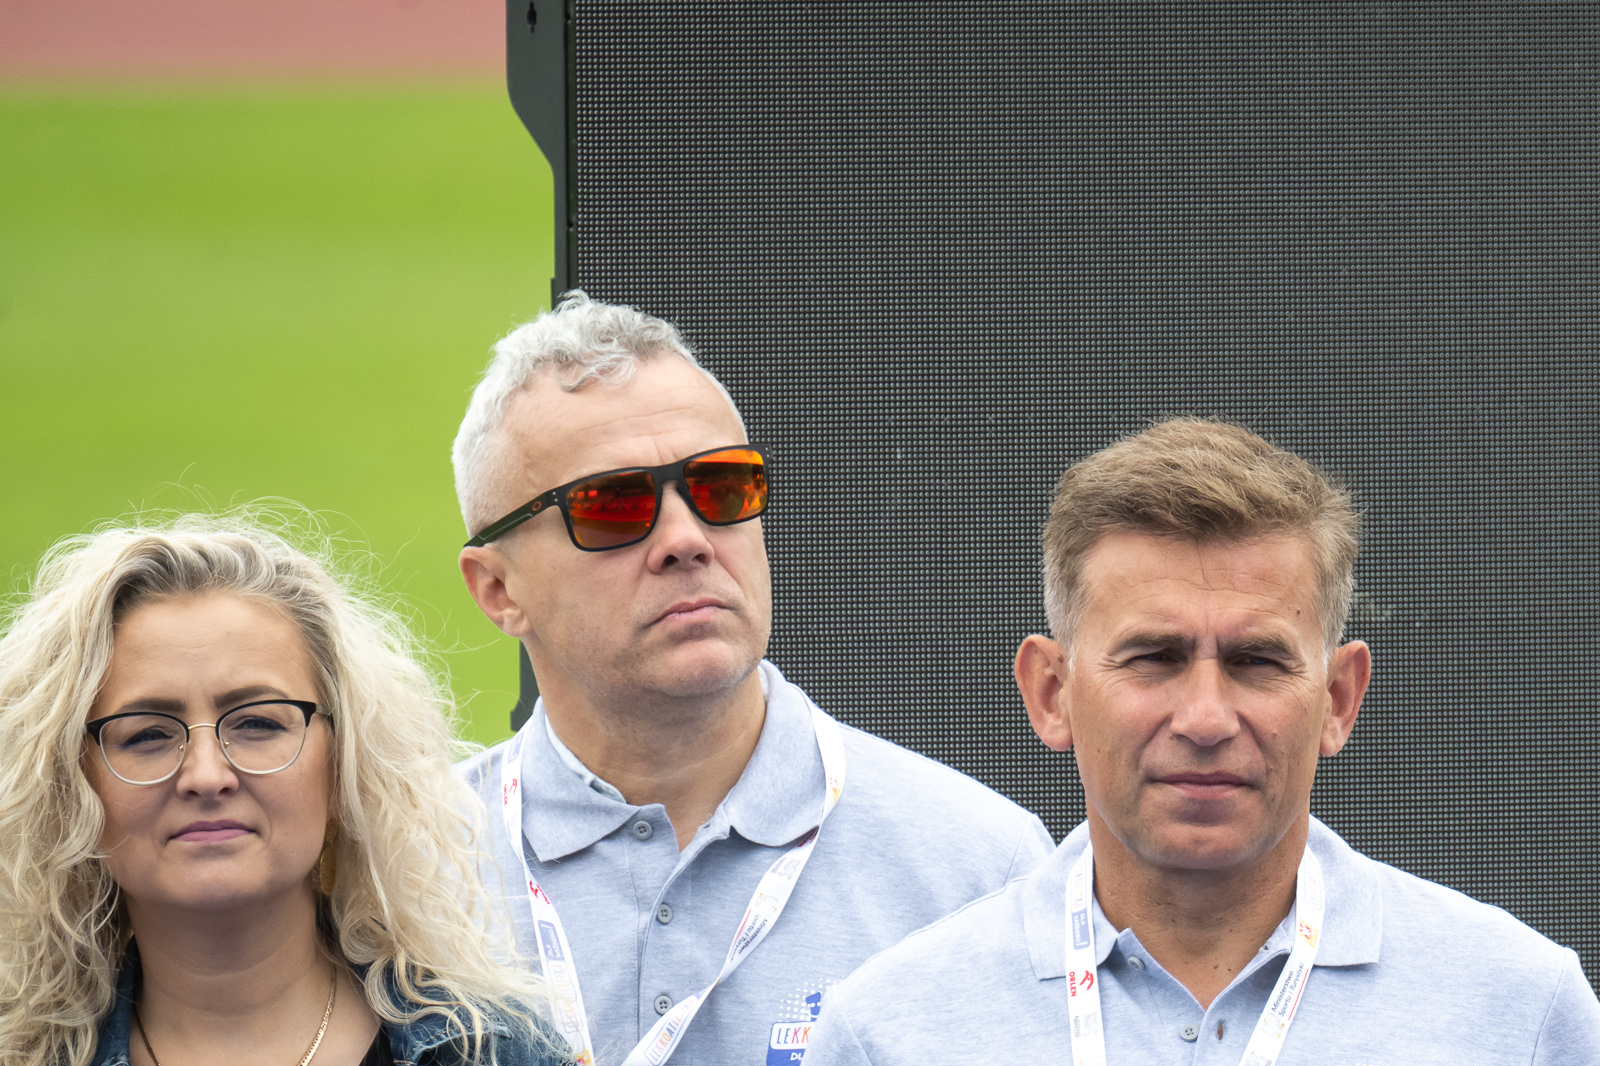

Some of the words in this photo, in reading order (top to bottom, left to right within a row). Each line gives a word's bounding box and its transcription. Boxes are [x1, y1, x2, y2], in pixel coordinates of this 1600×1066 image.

[1069, 971, 1077, 997] ORLEN
[1271, 971, 1294, 1012] Ministerstwo
[1278, 994, 1293, 1017] Sportu
[1290, 963, 1305, 990] Turystyki
